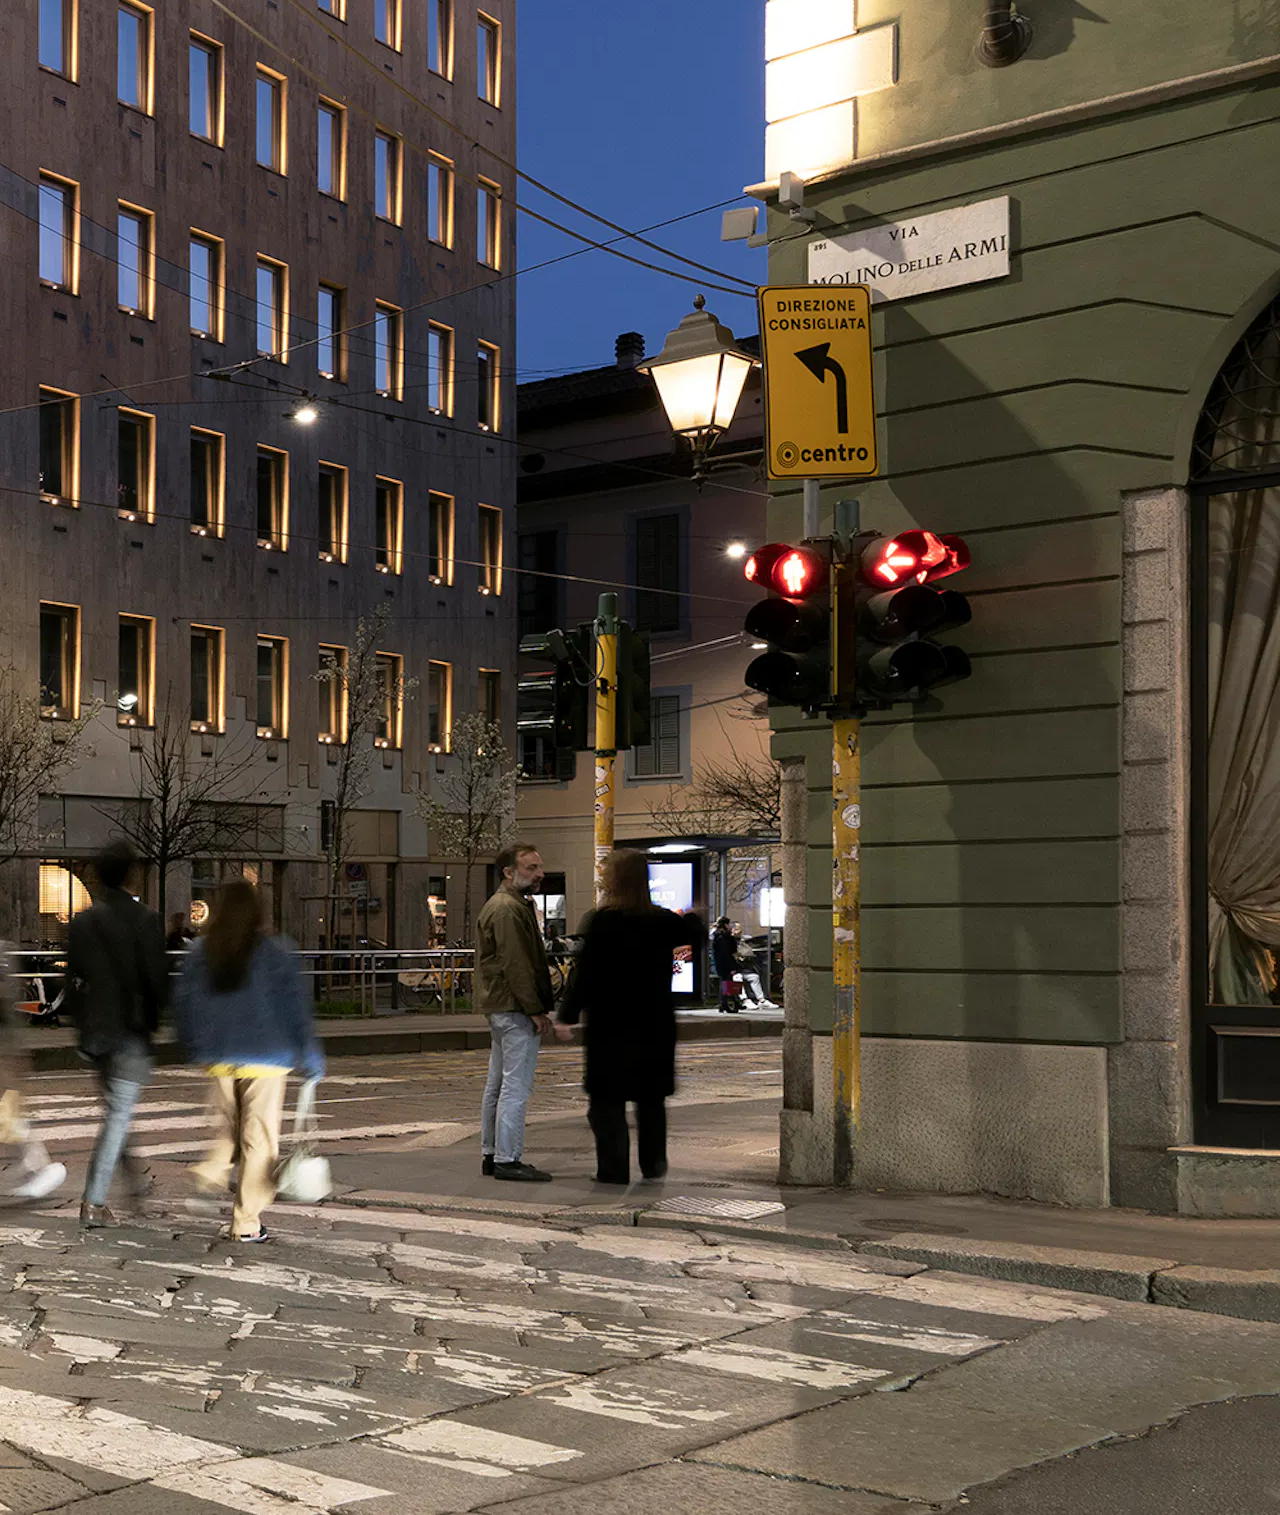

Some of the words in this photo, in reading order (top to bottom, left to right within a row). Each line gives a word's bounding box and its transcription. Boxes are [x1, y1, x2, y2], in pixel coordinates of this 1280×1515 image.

[890, 226, 919, 241] VIA
[898, 254, 943, 274] DELLE
[948, 235, 1006, 263] ARMI
[777, 299, 856, 313] DIREZIONE
[768, 318, 866, 331] CONSIGLIATA
[801, 444, 868, 462] centro
